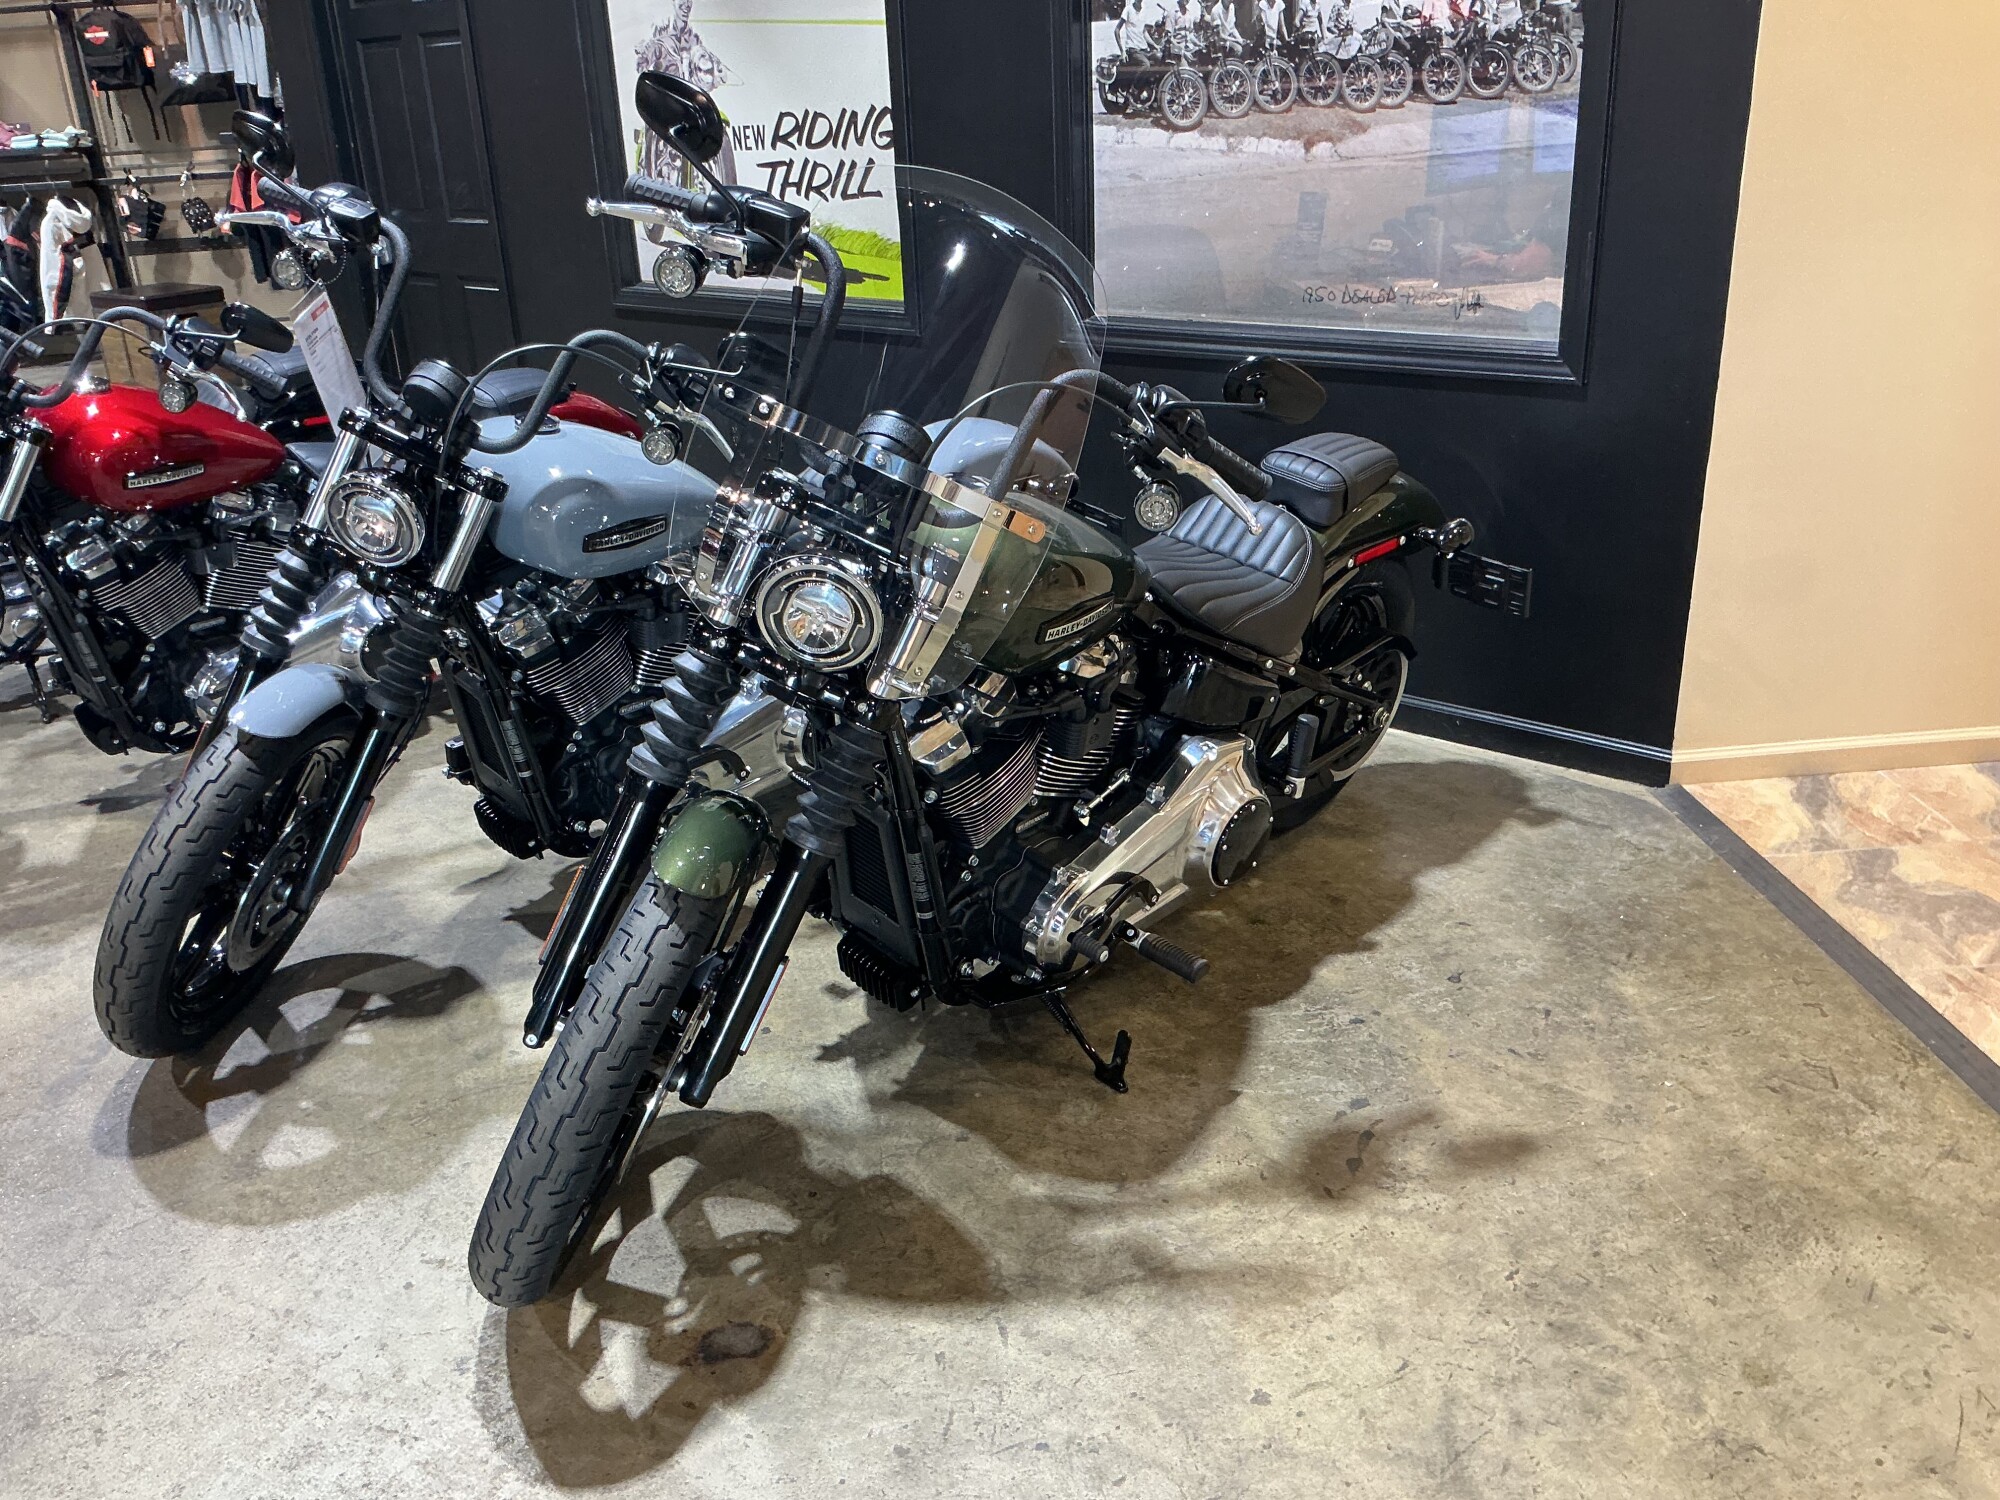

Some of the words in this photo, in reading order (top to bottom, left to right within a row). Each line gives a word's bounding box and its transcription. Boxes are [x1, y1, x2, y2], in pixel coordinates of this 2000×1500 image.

[732, 124, 766, 150] NEW
[771, 104, 894, 151] RIDING
[756, 157, 883, 203] THRILL
[1302, 286, 1336, 303] 1950
[591, 522, 665, 549] HARLEY-DAVIDSON
